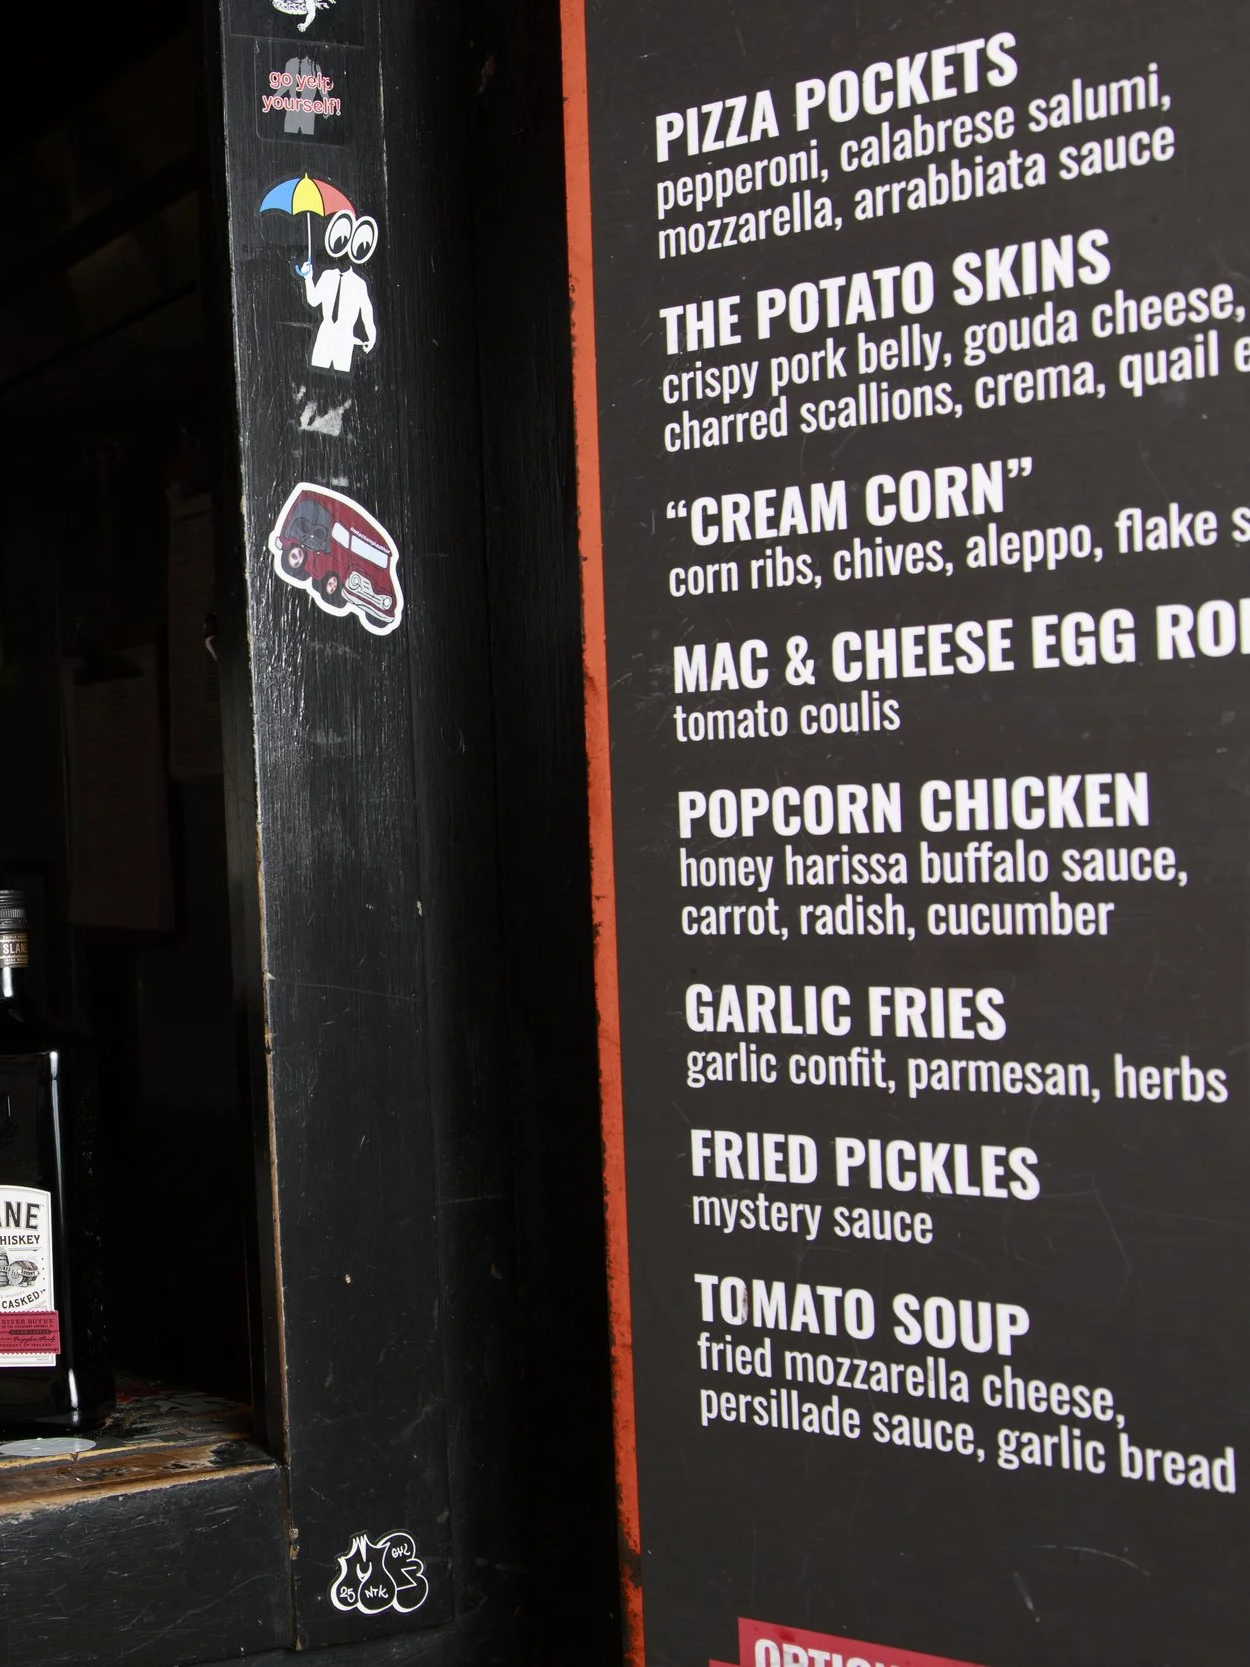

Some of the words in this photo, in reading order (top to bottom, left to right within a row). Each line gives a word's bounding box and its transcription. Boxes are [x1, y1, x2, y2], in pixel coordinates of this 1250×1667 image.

[262, 95, 342, 116] yourself!
[269, 71, 292, 89] go
[295, 72, 334, 94] yelp
[655, 89, 780, 163] PIZZA
[795, 31, 1018, 132] POCKETS
[657, 138, 829, 220] pepperoni,
[840, 106, 1015, 172] calabrese
[1028, 62, 1171, 133] salumi,
[658, 189, 843, 260] mozzarella,
[854, 149, 1046, 221] arrabbiata
[1059, 125, 1175, 180] sauce
[659, 295, 742, 356] THE
[756, 261, 934, 340] POTATO
[952, 228, 1111, 306] SKINS
[662, 360, 759, 405] crispy
[770, 337, 848, 397] pork
[857, 323, 952, 375] belly,
[964, 300, 1078, 367] gouda
[1092, 283, 1246, 343] cheese,
[664, 395, 788, 453] charred
[800, 381, 963, 434] scallions,
[975, 361, 1106, 409] crema,
[1119, 329, 1219, 398] quail
[669, 561, 739, 598] corn
[750, 545, 822, 590] ribs,
[833, 536, 954, 581] chives,
[966, 522, 1103, 573] aleppo,
[1114, 502, 1218, 554] flake
[673, 638, 769, 694] MAC
[785, 635, 816, 686] &
[832, 618, 1015, 683] CHEESE
[1031, 608, 1136, 669] EGG
[673, 699, 788, 743] tomato
[800, 689, 901, 735] coulis
[678, 782, 902, 839] POPCORN
[920, 771, 1149, 833] CHICKEN
[679, 847, 774, 893] honey
[785, 844, 908, 886] harissa
[920, 838, 1049, 884] buffalo
[1062, 846, 1188, 887] sauce,
[681, 897, 789, 941] carrot,
[800, 893, 916, 941] radish,
[927, 891, 1115, 936] cucumber
[685, 983, 852, 1036] GARLIC
[868, 986, 1007, 1041] FRIES
[686, 1041, 777, 1089] garlic
[789, 1046, 896, 1094] confit,
[908, 1058, 1101, 1104] parmesan,
[1114, 1053, 1229, 1104] herbs
[690, 1129, 818, 1184] FRIED
[835, 1137, 1041, 1201] PICKLES
[692, 1192, 822, 1241] mystery
[833, 1206, 933, 1245] sauce
[2, 1290, 40, 1309] CASKED
[694, 1273, 875, 1342] TOMATO
[892, 1293, 1030, 1356] SOUP
[697, 1331, 772, 1378] fried
[784, 1351, 970, 1403] mozzarella
[982, 1365, 1125, 1429] cheese,
[700, 1388, 861, 1439] persillade
[872, 1412, 985, 1463] sauce,
[997, 1424, 1106, 1474] garlic
[1119, 1432, 1236, 1494] bread
